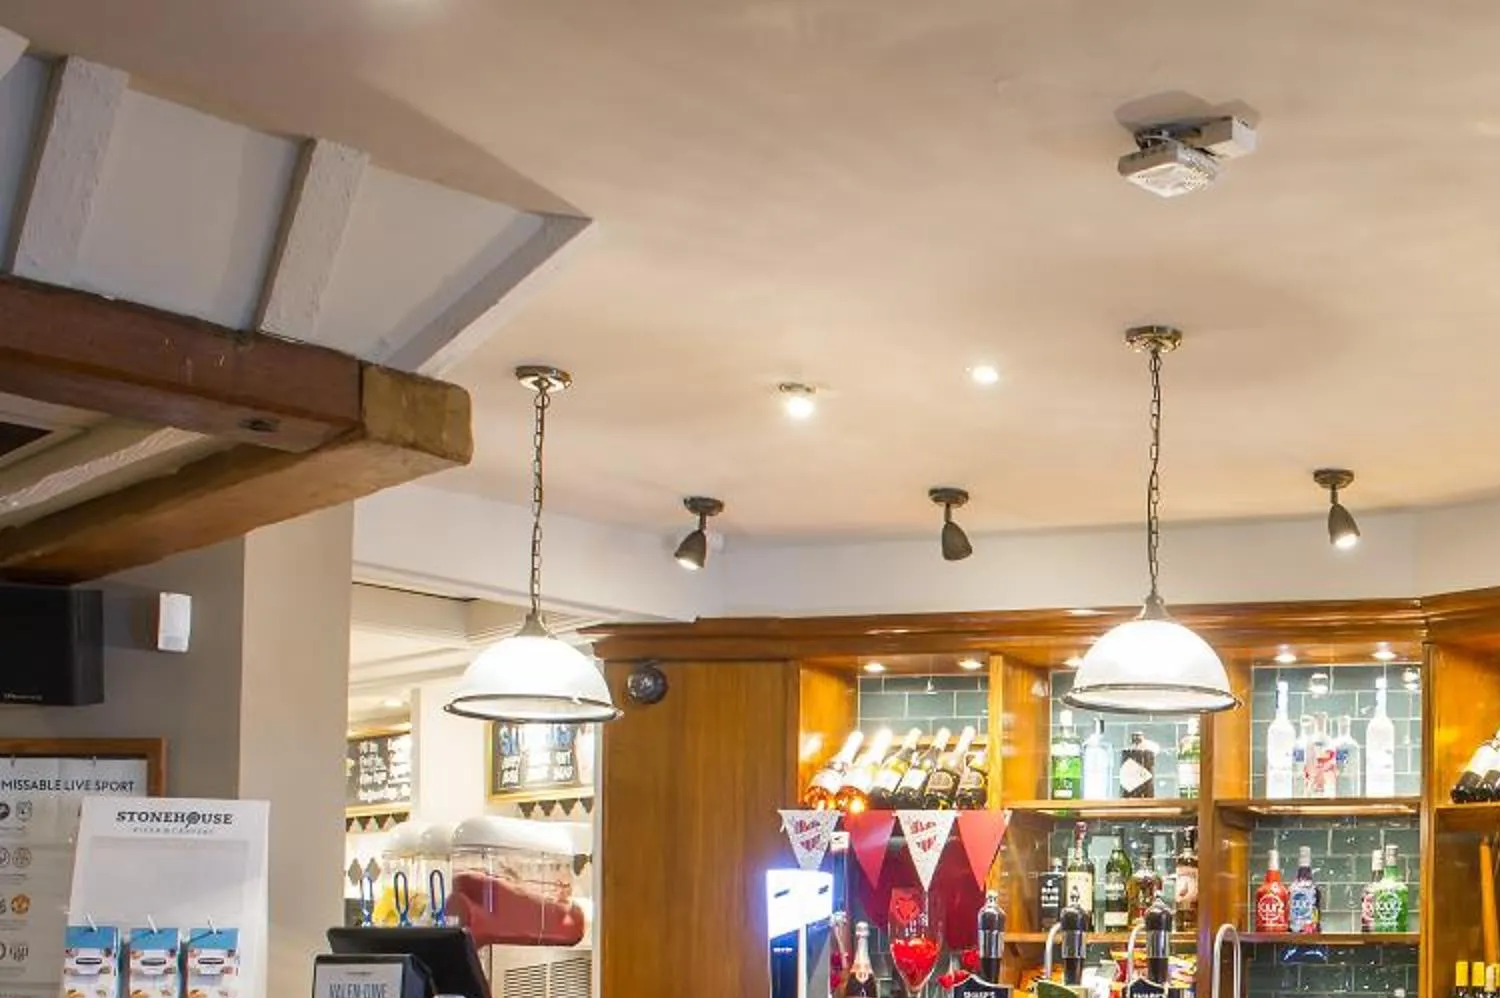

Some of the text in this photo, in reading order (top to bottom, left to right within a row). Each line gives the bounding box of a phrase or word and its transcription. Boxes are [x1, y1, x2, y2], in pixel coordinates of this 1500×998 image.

[64, 780, 91, 791] LIVE
[94, 780, 135, 792] SPORT
[116, 811, 233, 828] STONEHOUSE
